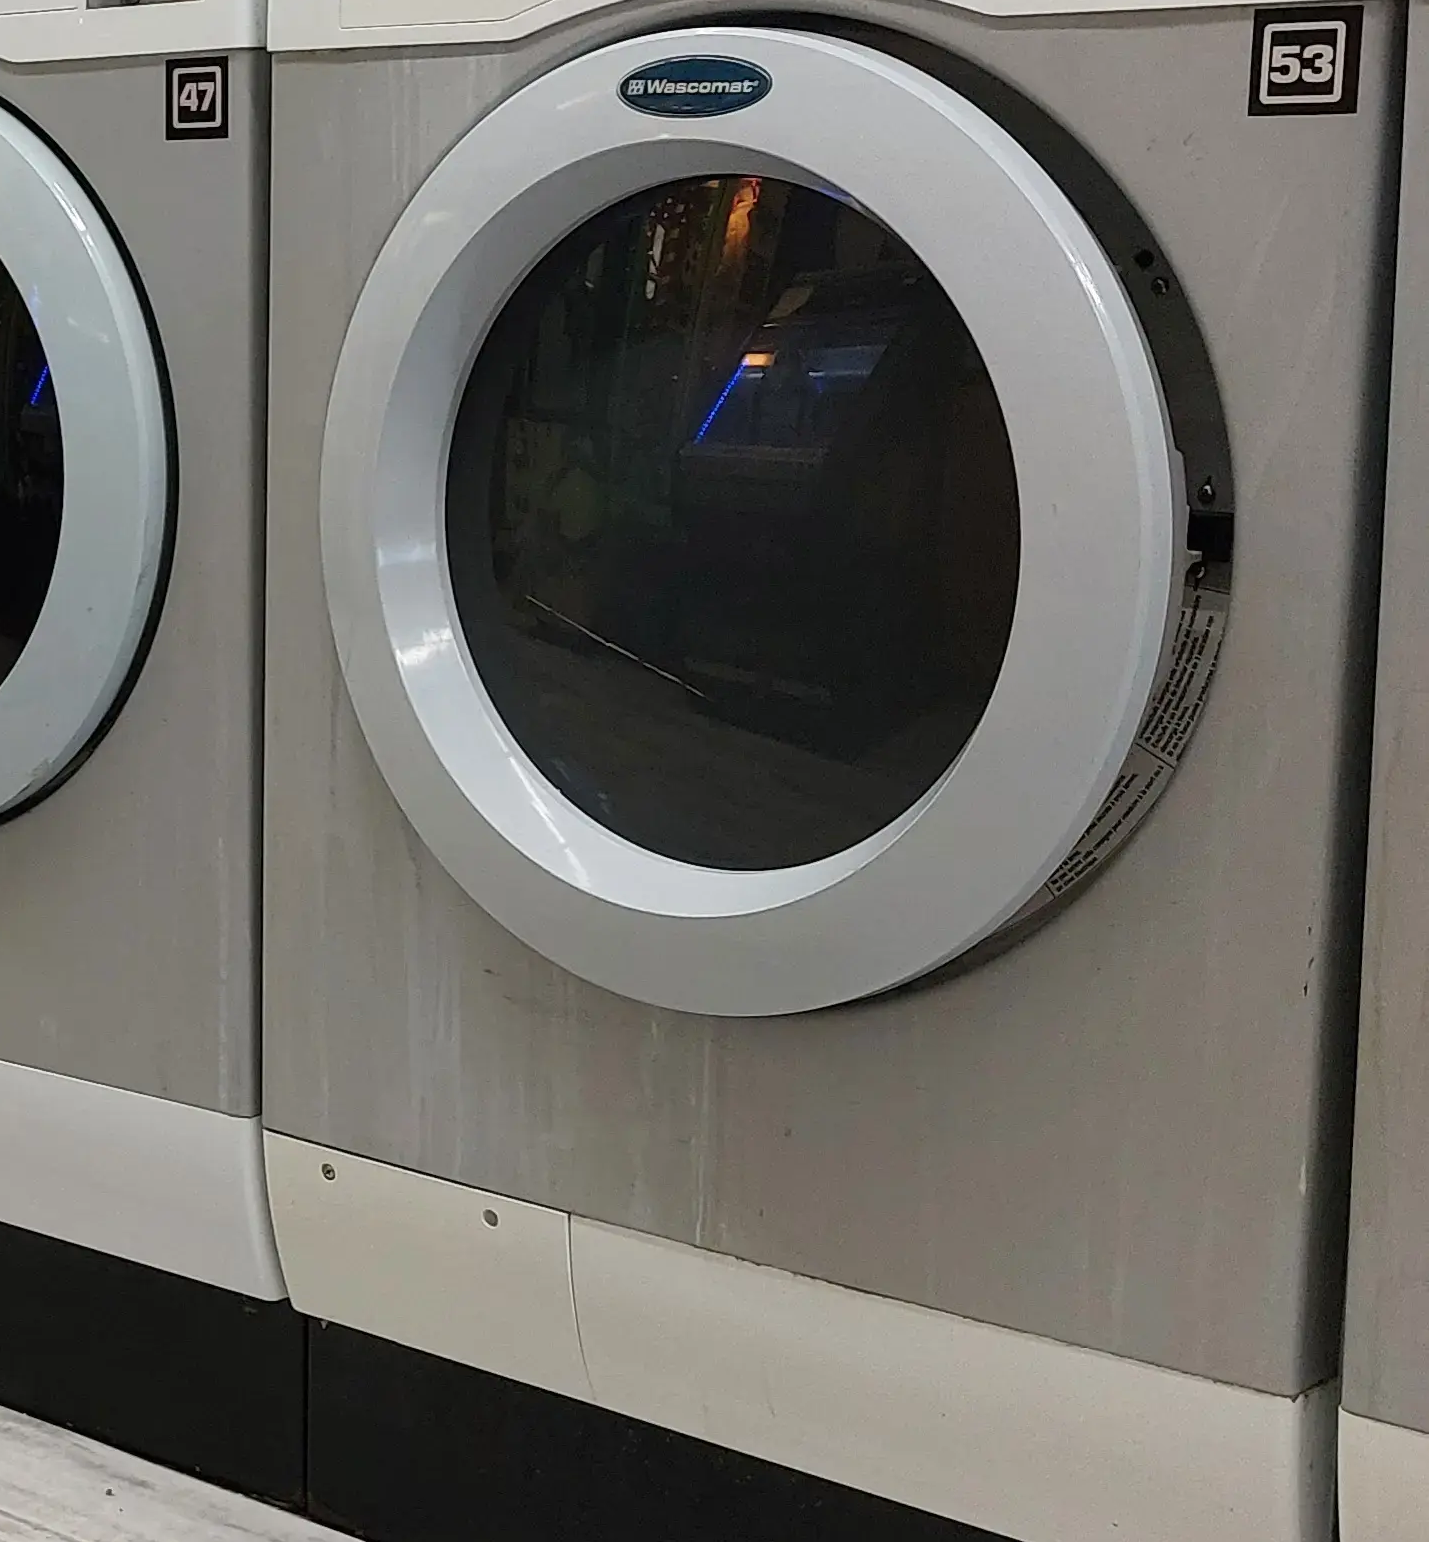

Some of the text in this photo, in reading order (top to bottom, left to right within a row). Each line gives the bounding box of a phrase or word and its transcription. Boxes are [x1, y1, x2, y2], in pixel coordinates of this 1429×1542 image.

[1269, 44, 1334, 84] 53
[179, 81, 216, 113] 47
[646, 78, 754, 95] Wascomat
